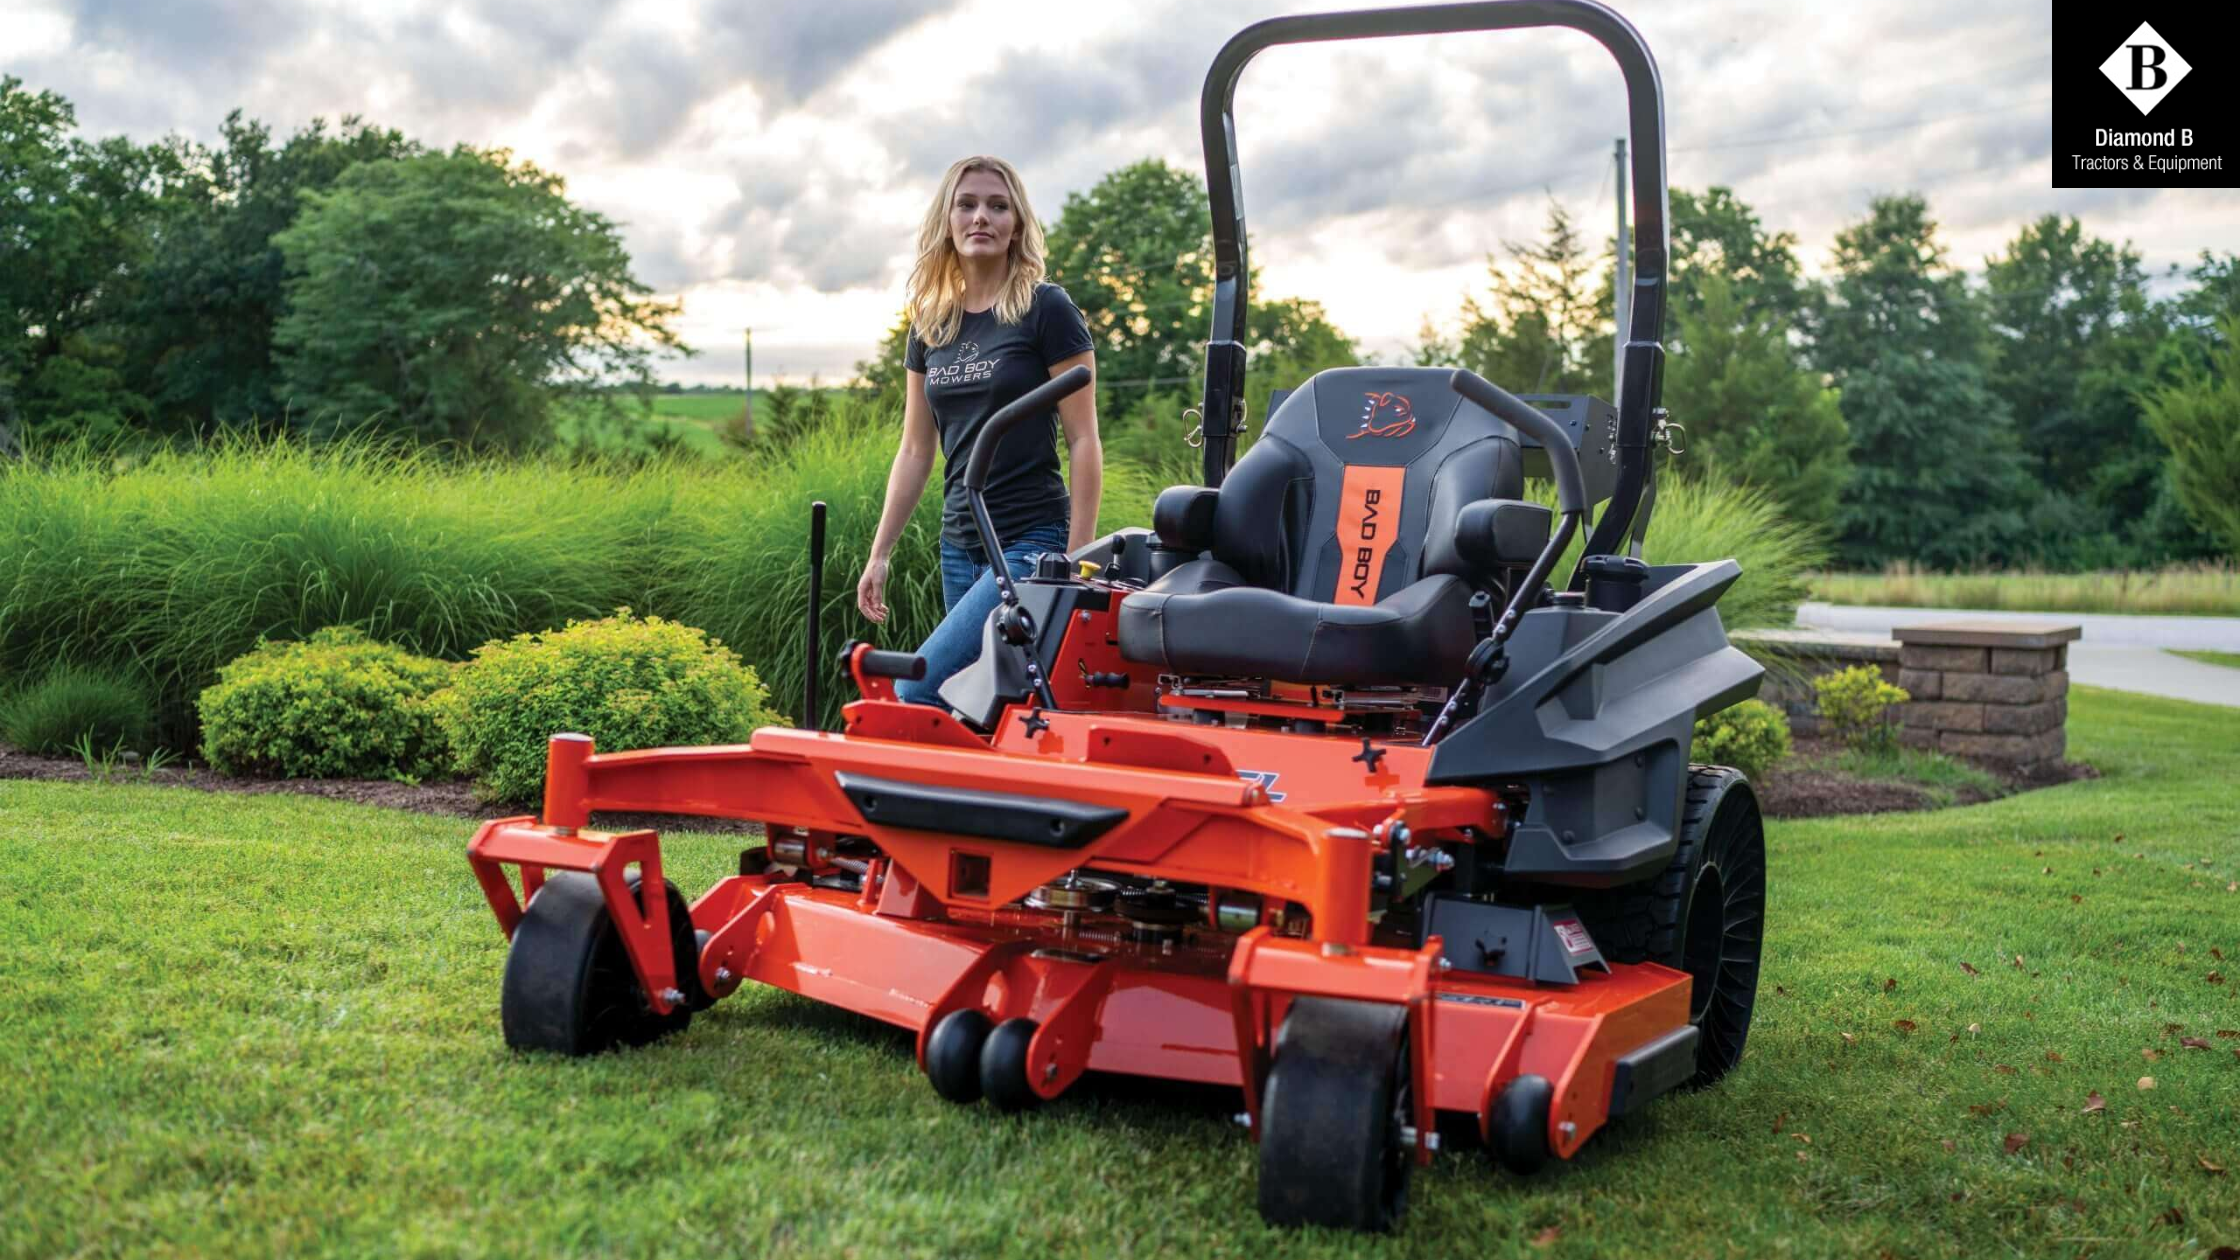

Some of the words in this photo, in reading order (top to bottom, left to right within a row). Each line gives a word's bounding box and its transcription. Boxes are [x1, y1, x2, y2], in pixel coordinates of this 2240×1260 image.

[929, 365, 960, 378] BAD
[965, 359, 1000, 373] BOY
[929, 370, 992, 385] MOWERS
[1361, 489, 1381, 540] BAD
[1350, 548, 1373, 599] BOY
